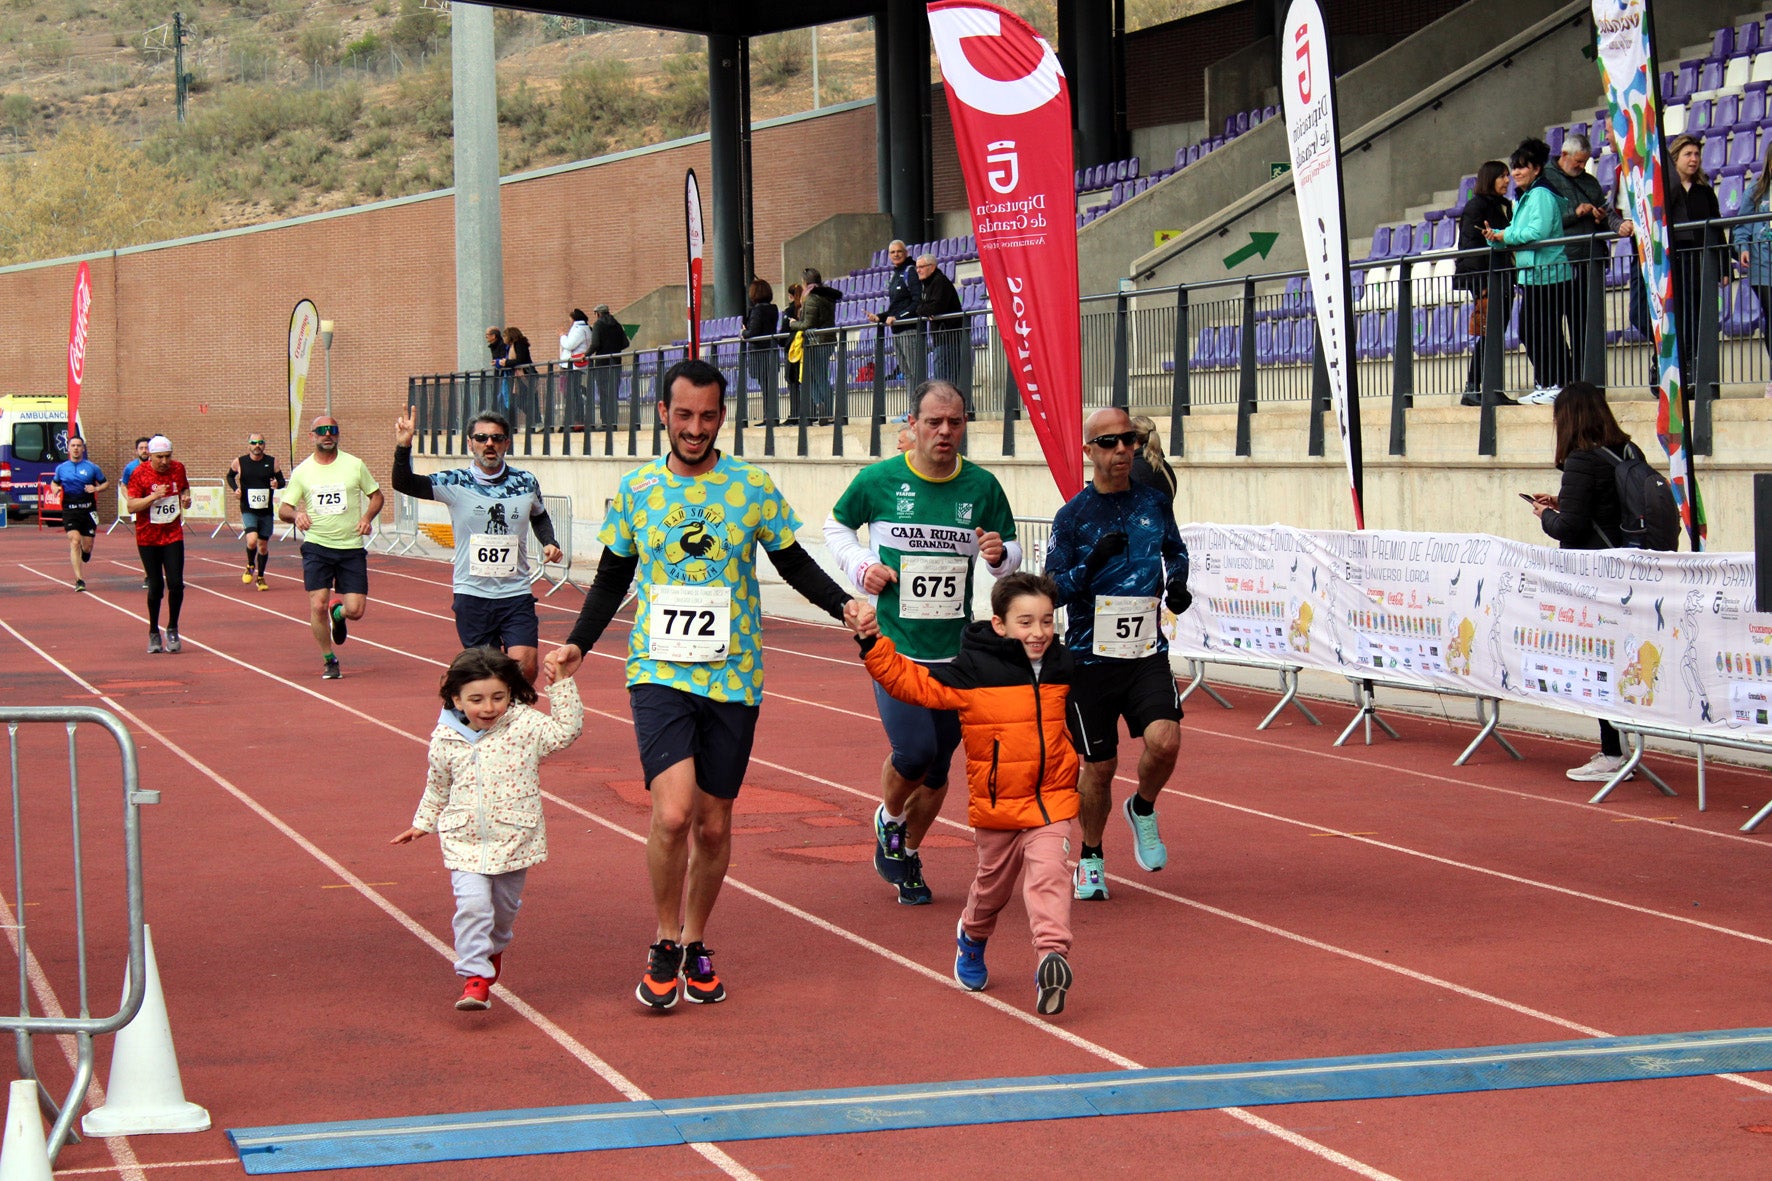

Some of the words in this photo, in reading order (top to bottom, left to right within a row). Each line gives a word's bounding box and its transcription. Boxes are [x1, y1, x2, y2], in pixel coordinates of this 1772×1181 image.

[252, 495, 266, 503] 263
[317, 493, 341, 505] 725
[155, 504, 176, 515] 766
[664, 509, 684, 529] BAR
[690, 508, 722, 529] SORIA
[891, 527, 925, 539] CAJA
[930, 528, 972, 544] RURAL
[909, 539, 957, 550] GRANADA
[477, 547, 510, 563] 687
[1372, 535, 1407, 561] PREMIO
[1409, 541, 1424, 562] DE
[1425, 538, 1460, 563] FONDO
[1460, 539, 1491, 565] 2023
[1364, 564, 1402, 582] UNIVERSO
[1405, 566, 1430, 583] LORCA
[1579, 553, 1590, 577] DE
[1593, 552, 1626, 580] FONDO
[1629, 554, 1664, 582] 2023
[1676, 558, 1718, 585] XXXVI
[1719, 558, 1754, 587] GRAN
[912, 576, 956, 598] 675
[663, 609, 716, 636] 772
[1116, 616, 1144, 639] 57
